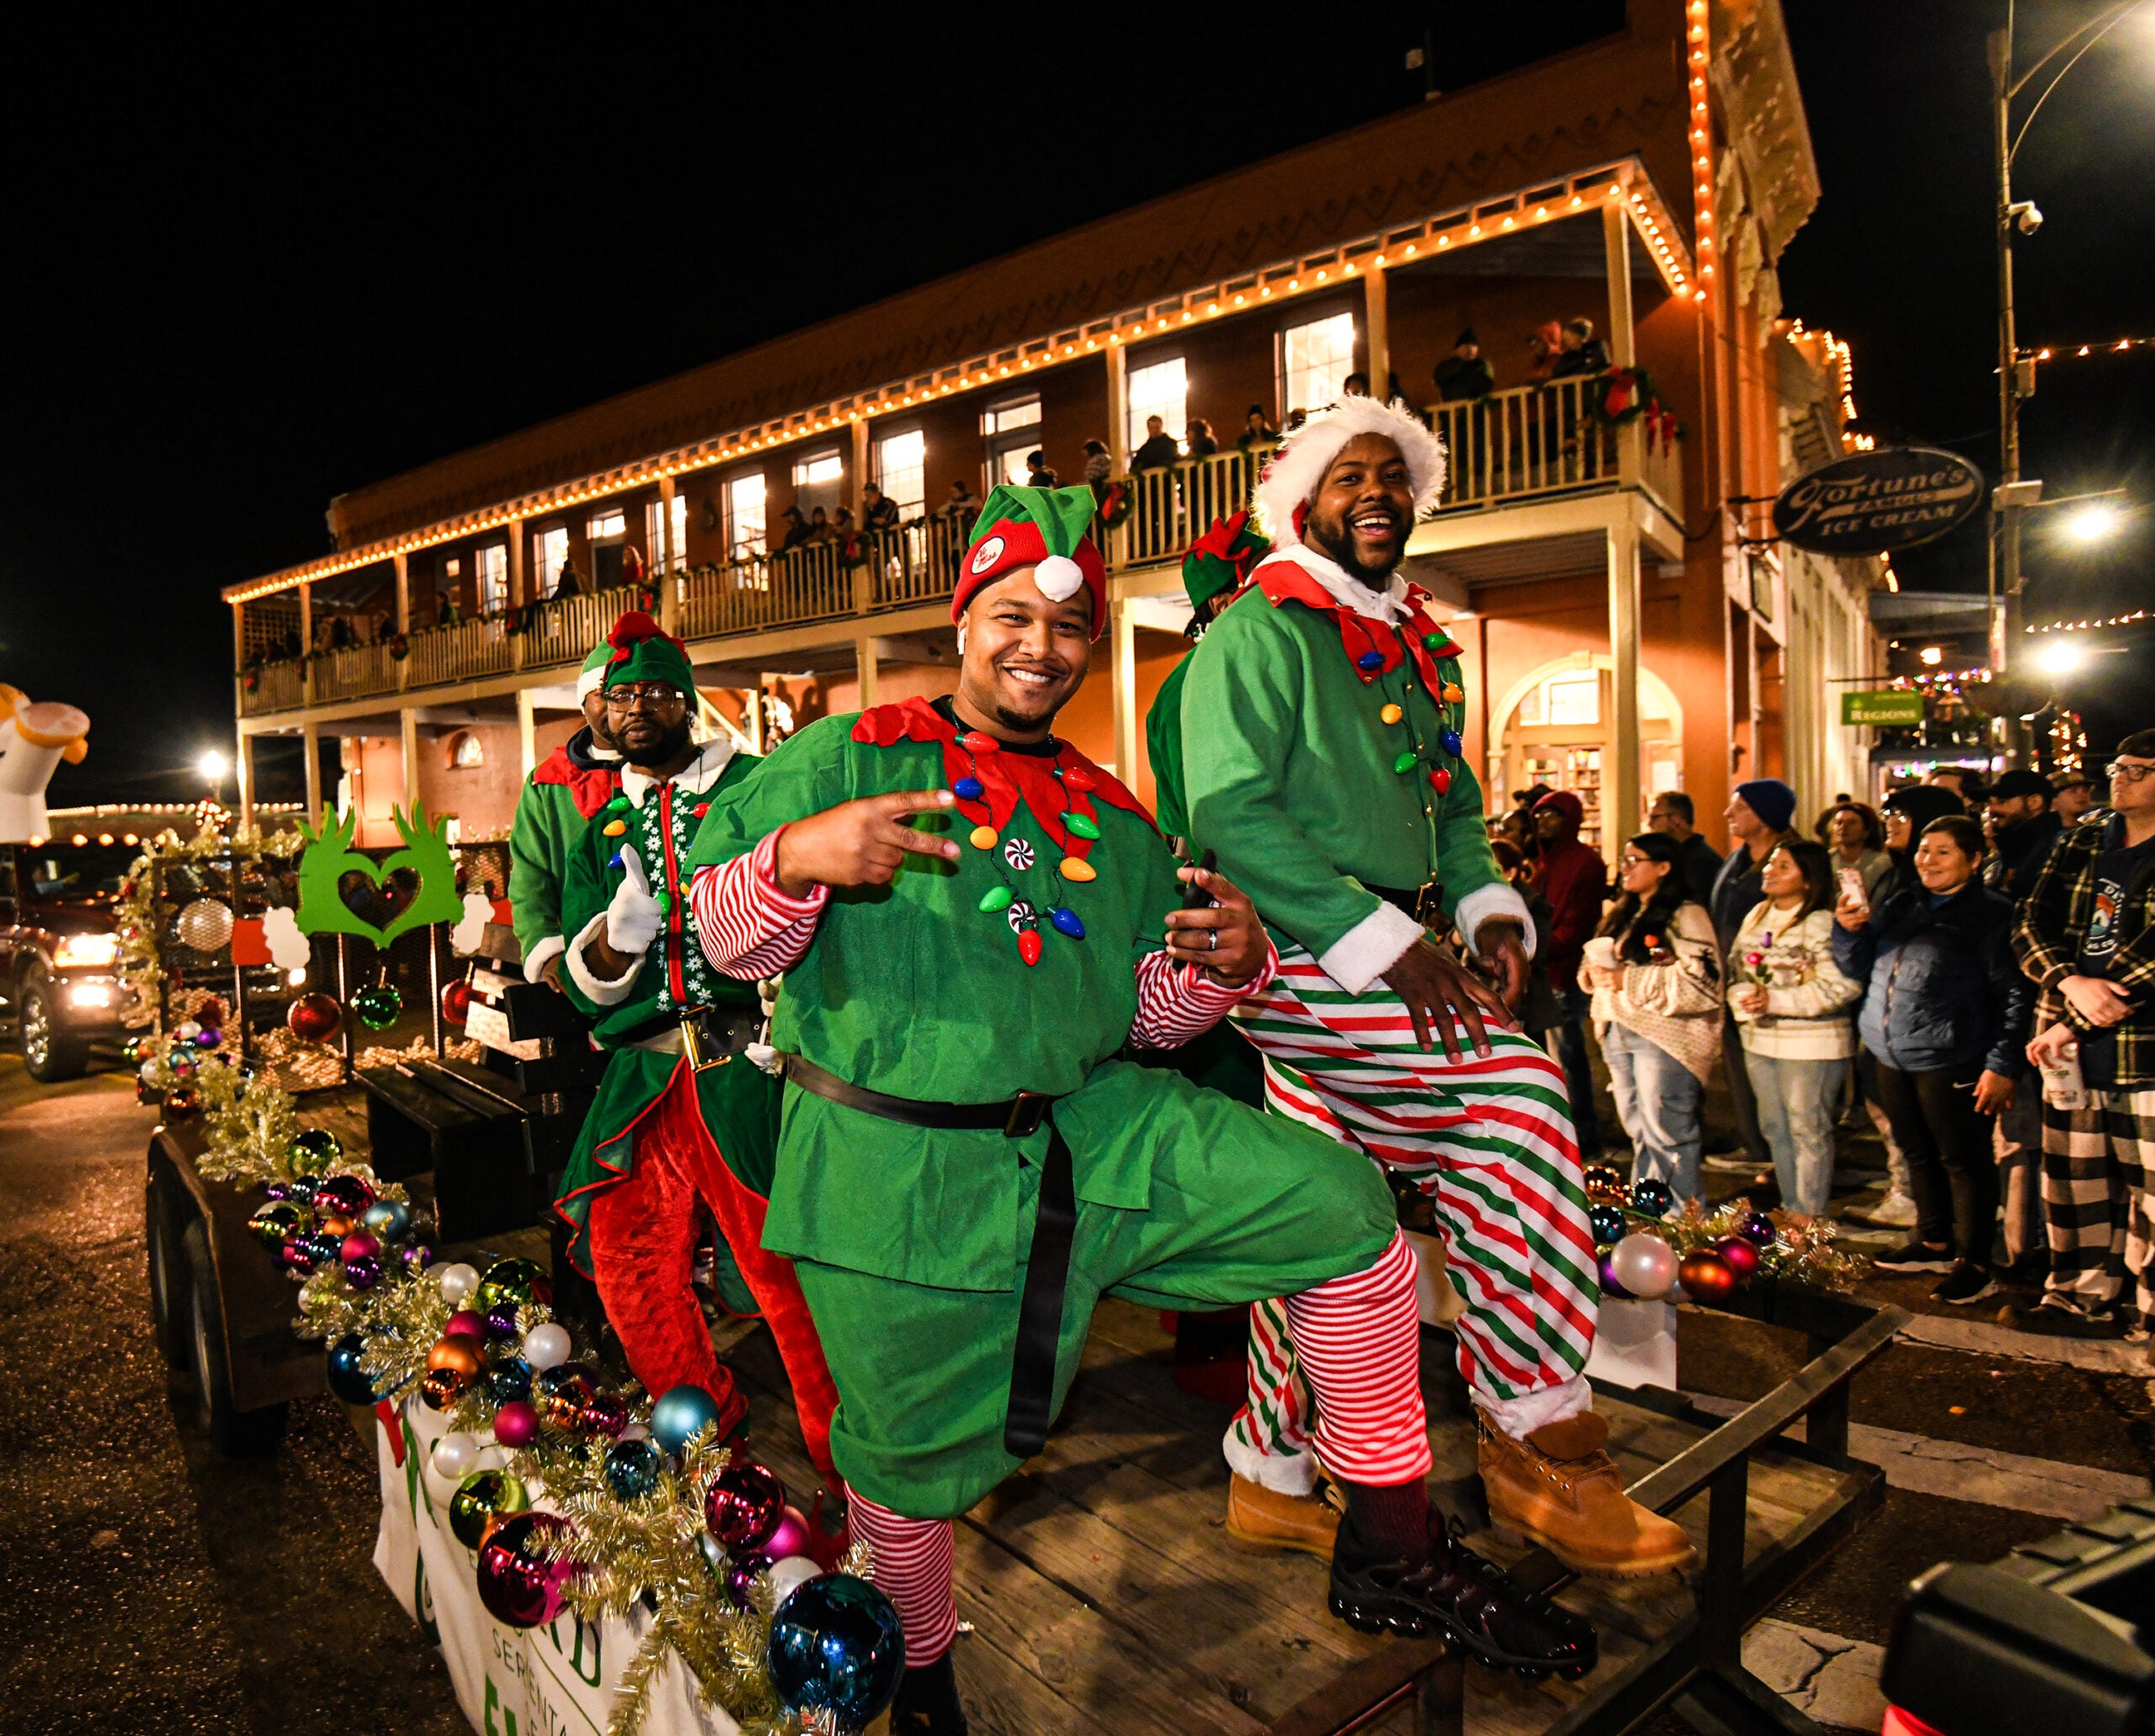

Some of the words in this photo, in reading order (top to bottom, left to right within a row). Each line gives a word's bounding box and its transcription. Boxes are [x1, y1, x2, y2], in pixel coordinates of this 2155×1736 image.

[1785, 466, 1967, 532] Fortune's
[1820, 518, 1863, 536] ICE
[1869, 504, 1955, 528] CREAM
